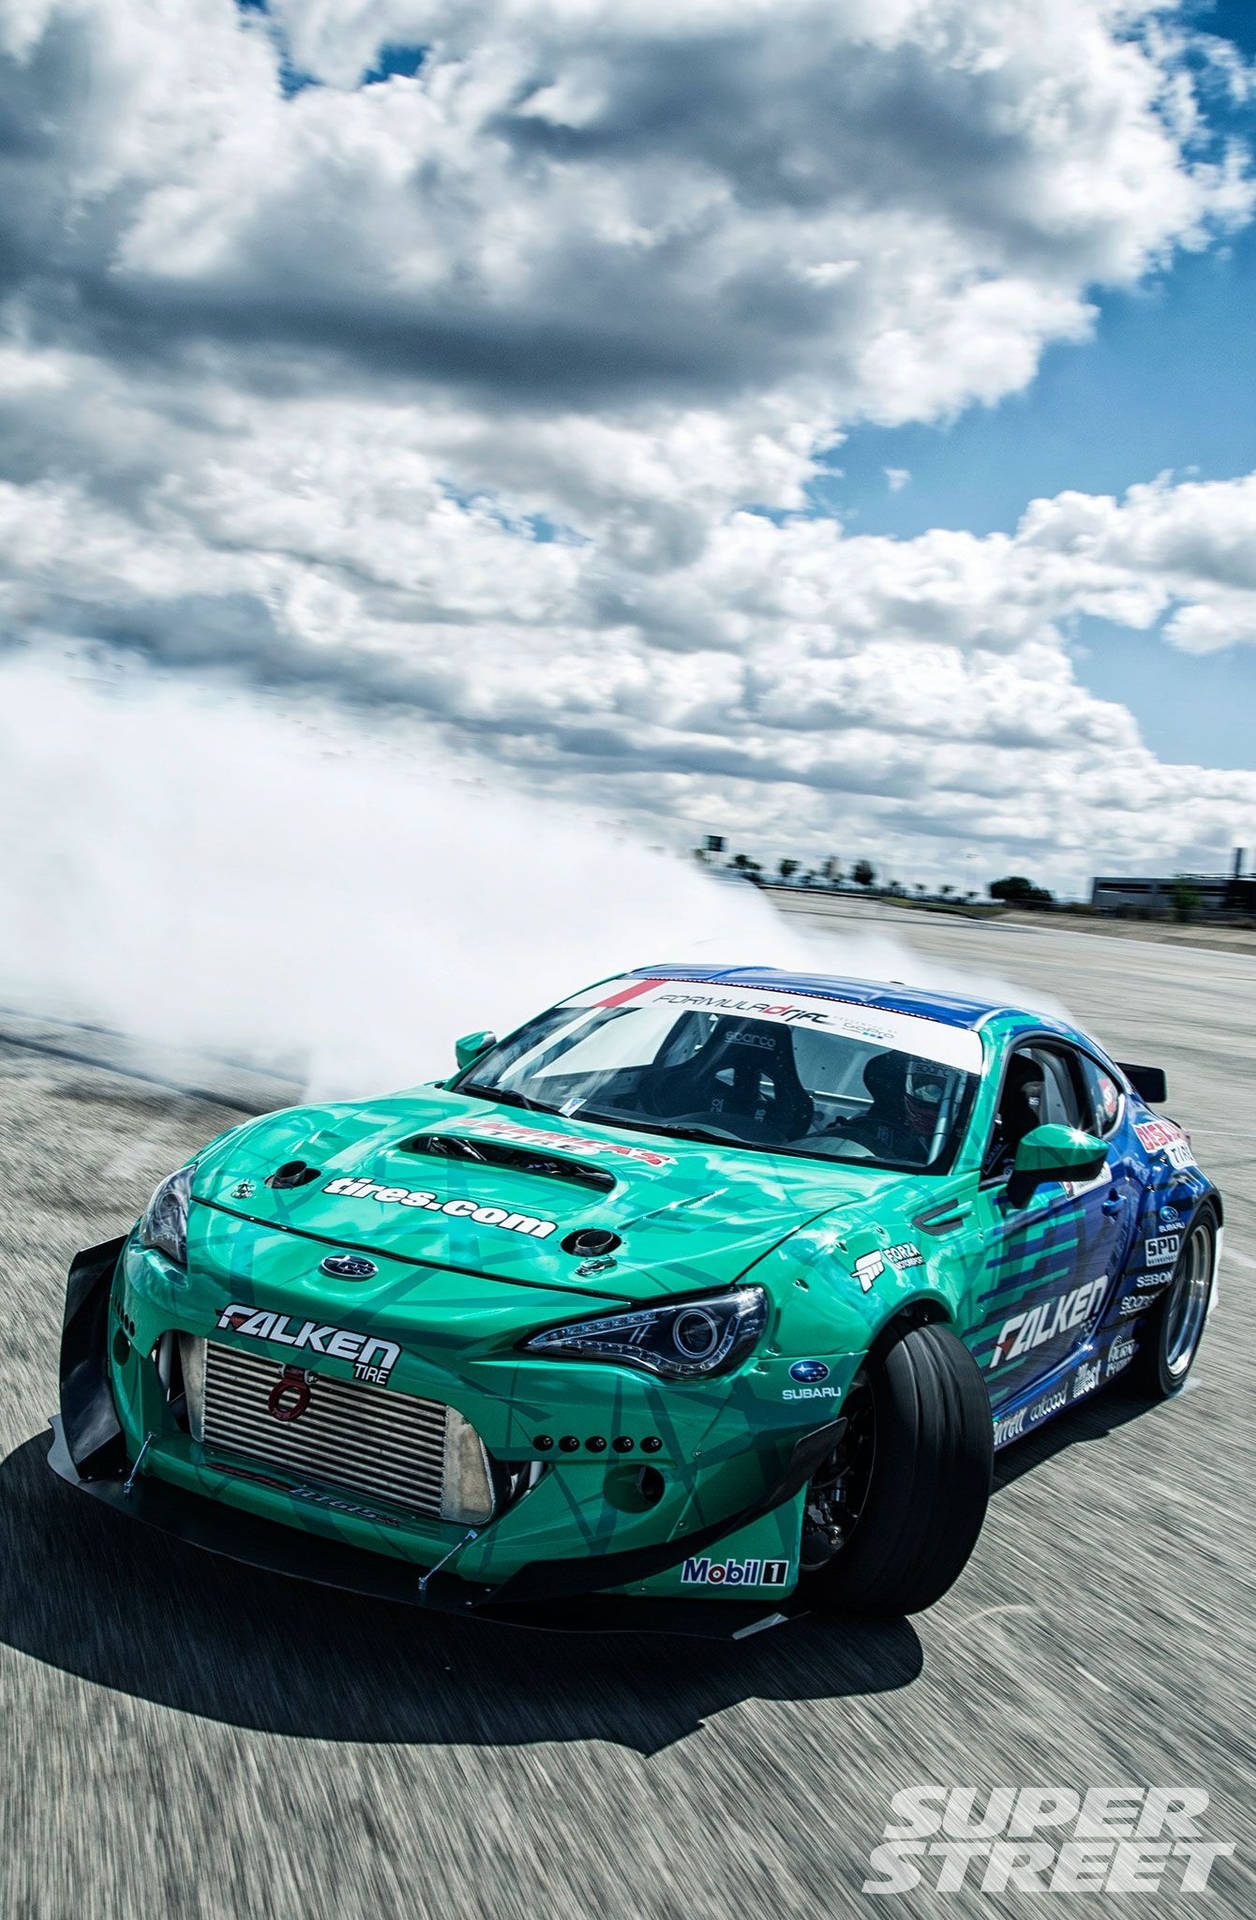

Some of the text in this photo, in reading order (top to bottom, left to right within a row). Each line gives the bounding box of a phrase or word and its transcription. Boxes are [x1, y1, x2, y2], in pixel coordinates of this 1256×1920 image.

[725, 1030, 777, 1049] sparco
[323, 1177, 558, 1239] tires.com
[883, 1241, 921, 1263] FORZA
[1147, 1236, 1178, 1257] SPD
[989, 1274, 1108, 1369] FALKEN
[217, 1303, 401, 1370] FALKEN
[354, 1362, 391, 1385] TIRE
[782, 1386, 842, 1400] SUBARU
[681, 1558, 760, 1585] Mobil
